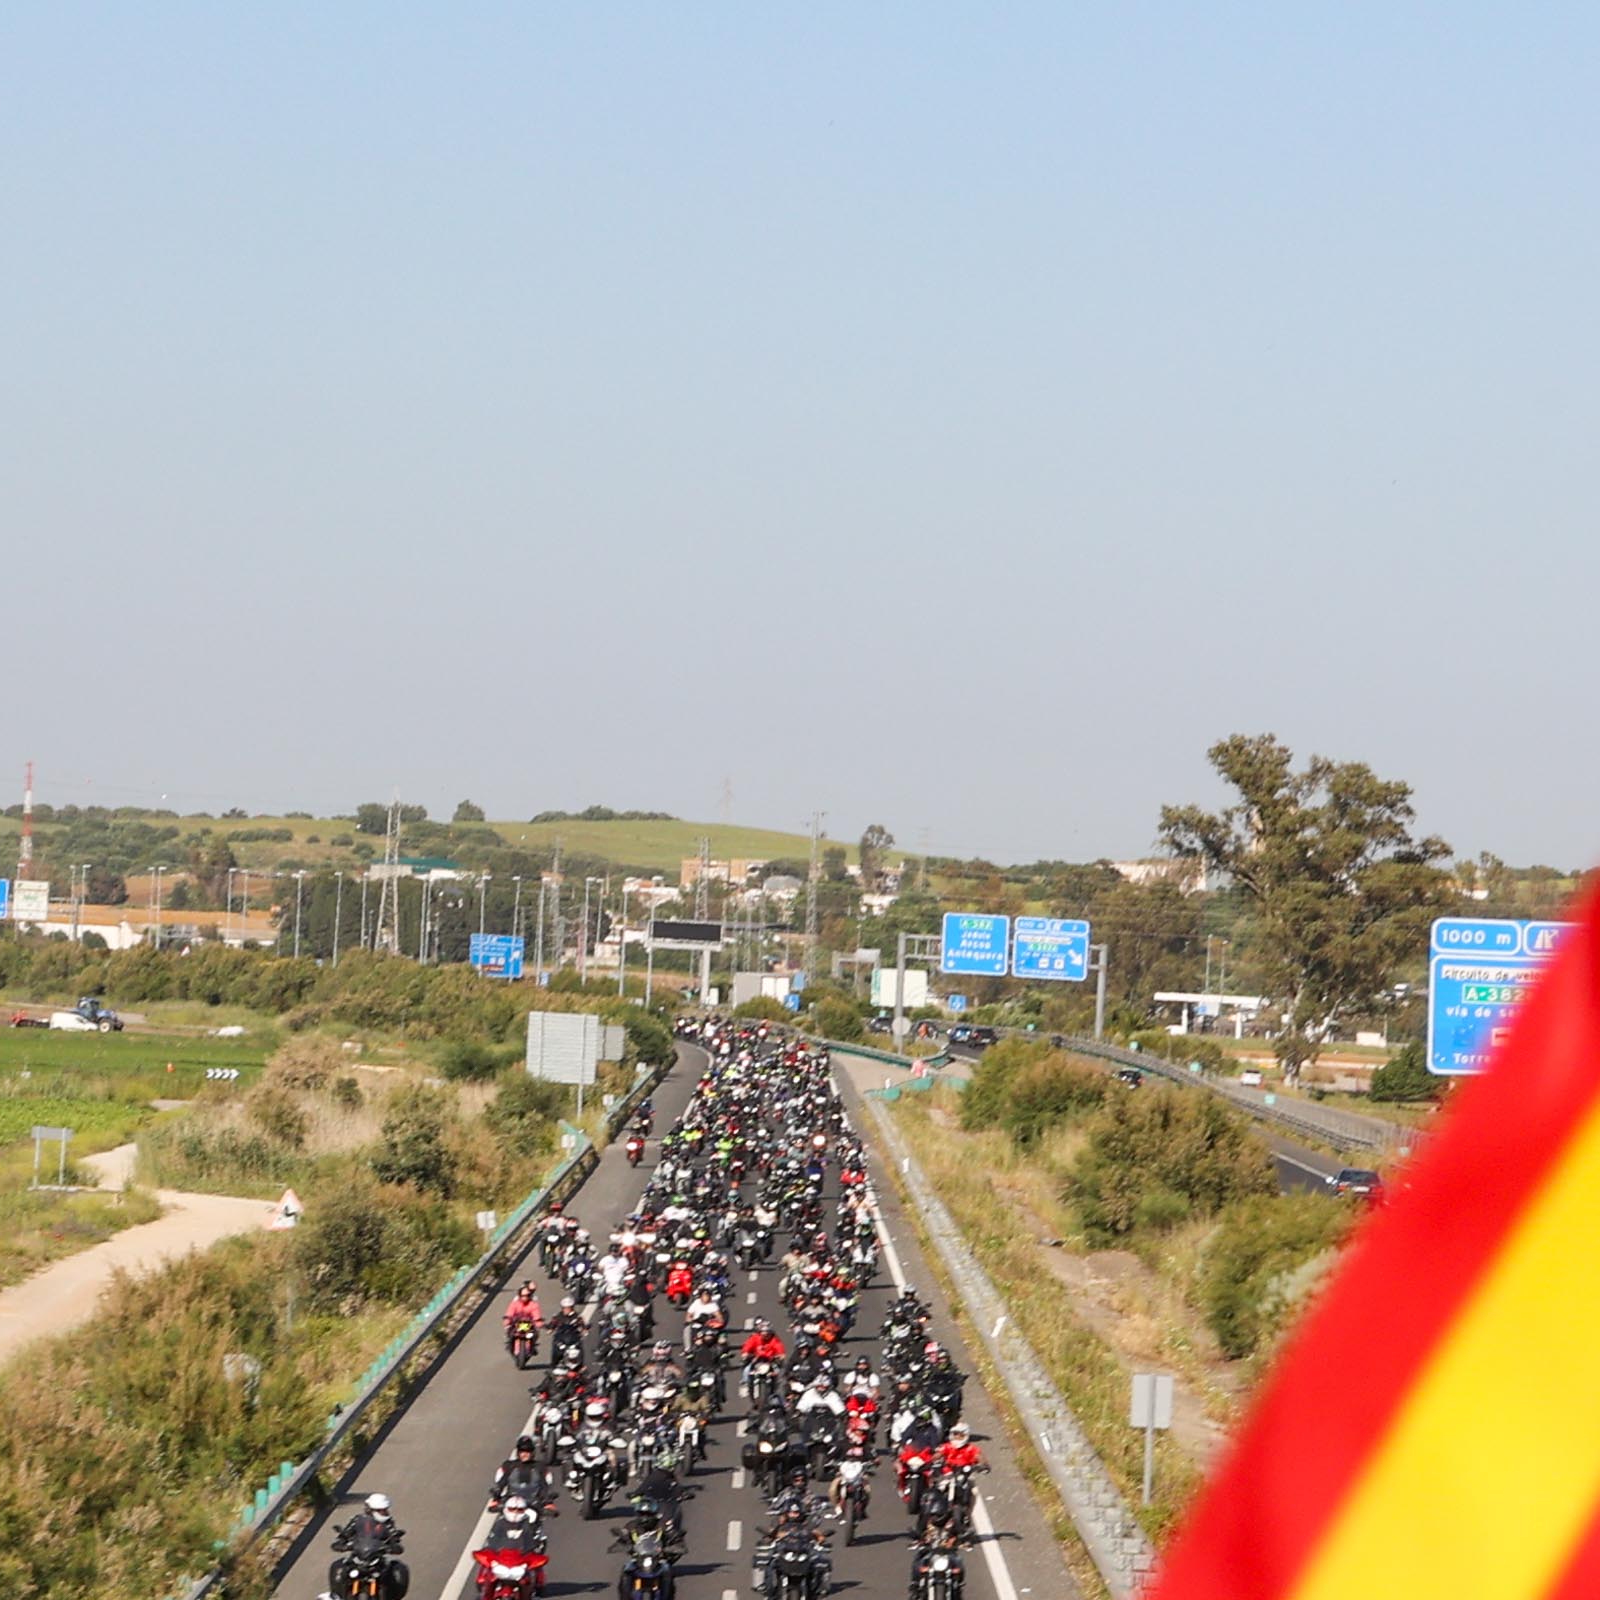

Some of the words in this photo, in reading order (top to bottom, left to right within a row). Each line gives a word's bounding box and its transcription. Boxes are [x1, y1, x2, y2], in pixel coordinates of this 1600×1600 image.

[1441, 929, 1487, 945] 1000
[1496, 933, 1511, 945] m
[1443, 968, 1489, 982] circuito
[1495, 970, 1510, 982] de
[1465, 986, 1526, 1002] A-382
[1474, 1005, 1491, 1018] de
[1453, 1053, 1492, 1064] Torre
